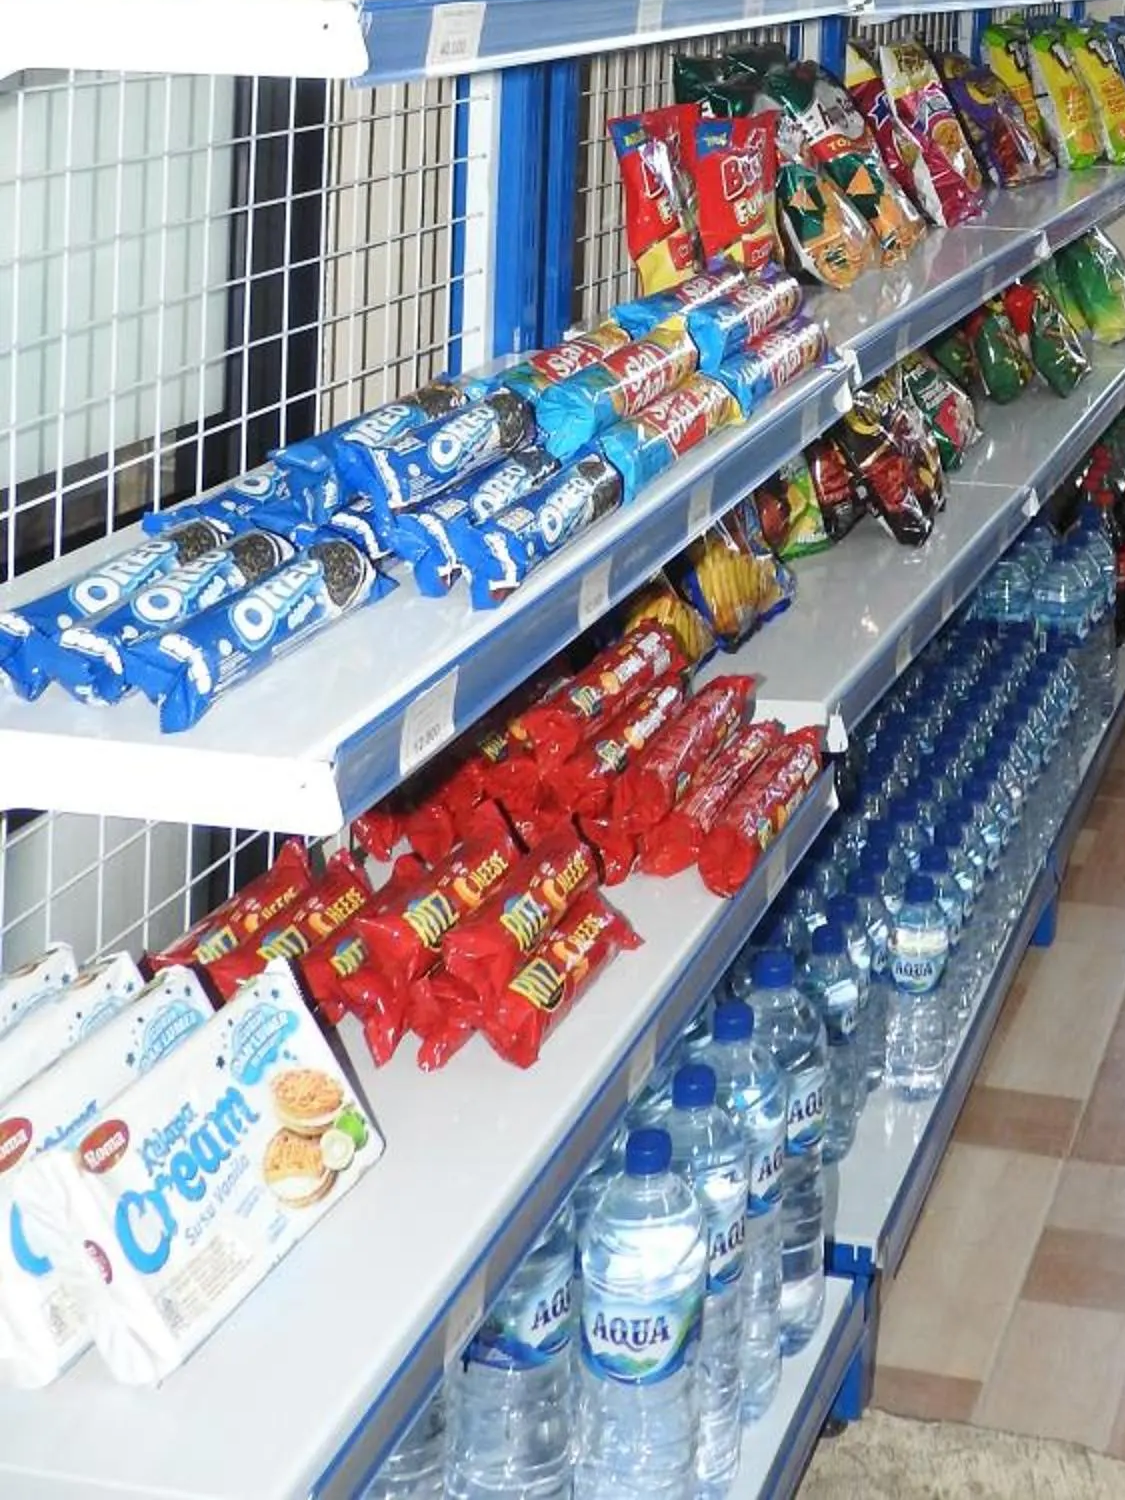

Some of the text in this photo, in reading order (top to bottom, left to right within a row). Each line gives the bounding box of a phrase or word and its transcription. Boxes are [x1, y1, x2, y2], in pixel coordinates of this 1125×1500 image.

[430, 405, 496, 469] OREO
[75, 541, 174, 614] OREO
[135, 550, 229, 623] OREO
[232, 560, 320, 642] OREO
[402, 890, 460, 952] RITZ
[500, 891, 549, 955] RITZ
[508, 957, 567, 1011] RITZ
[895, 961, 933, 980] AQUA
[114, 1086, 261, 1275] Cream
[591, 1310, 672, 1352] AQUA
